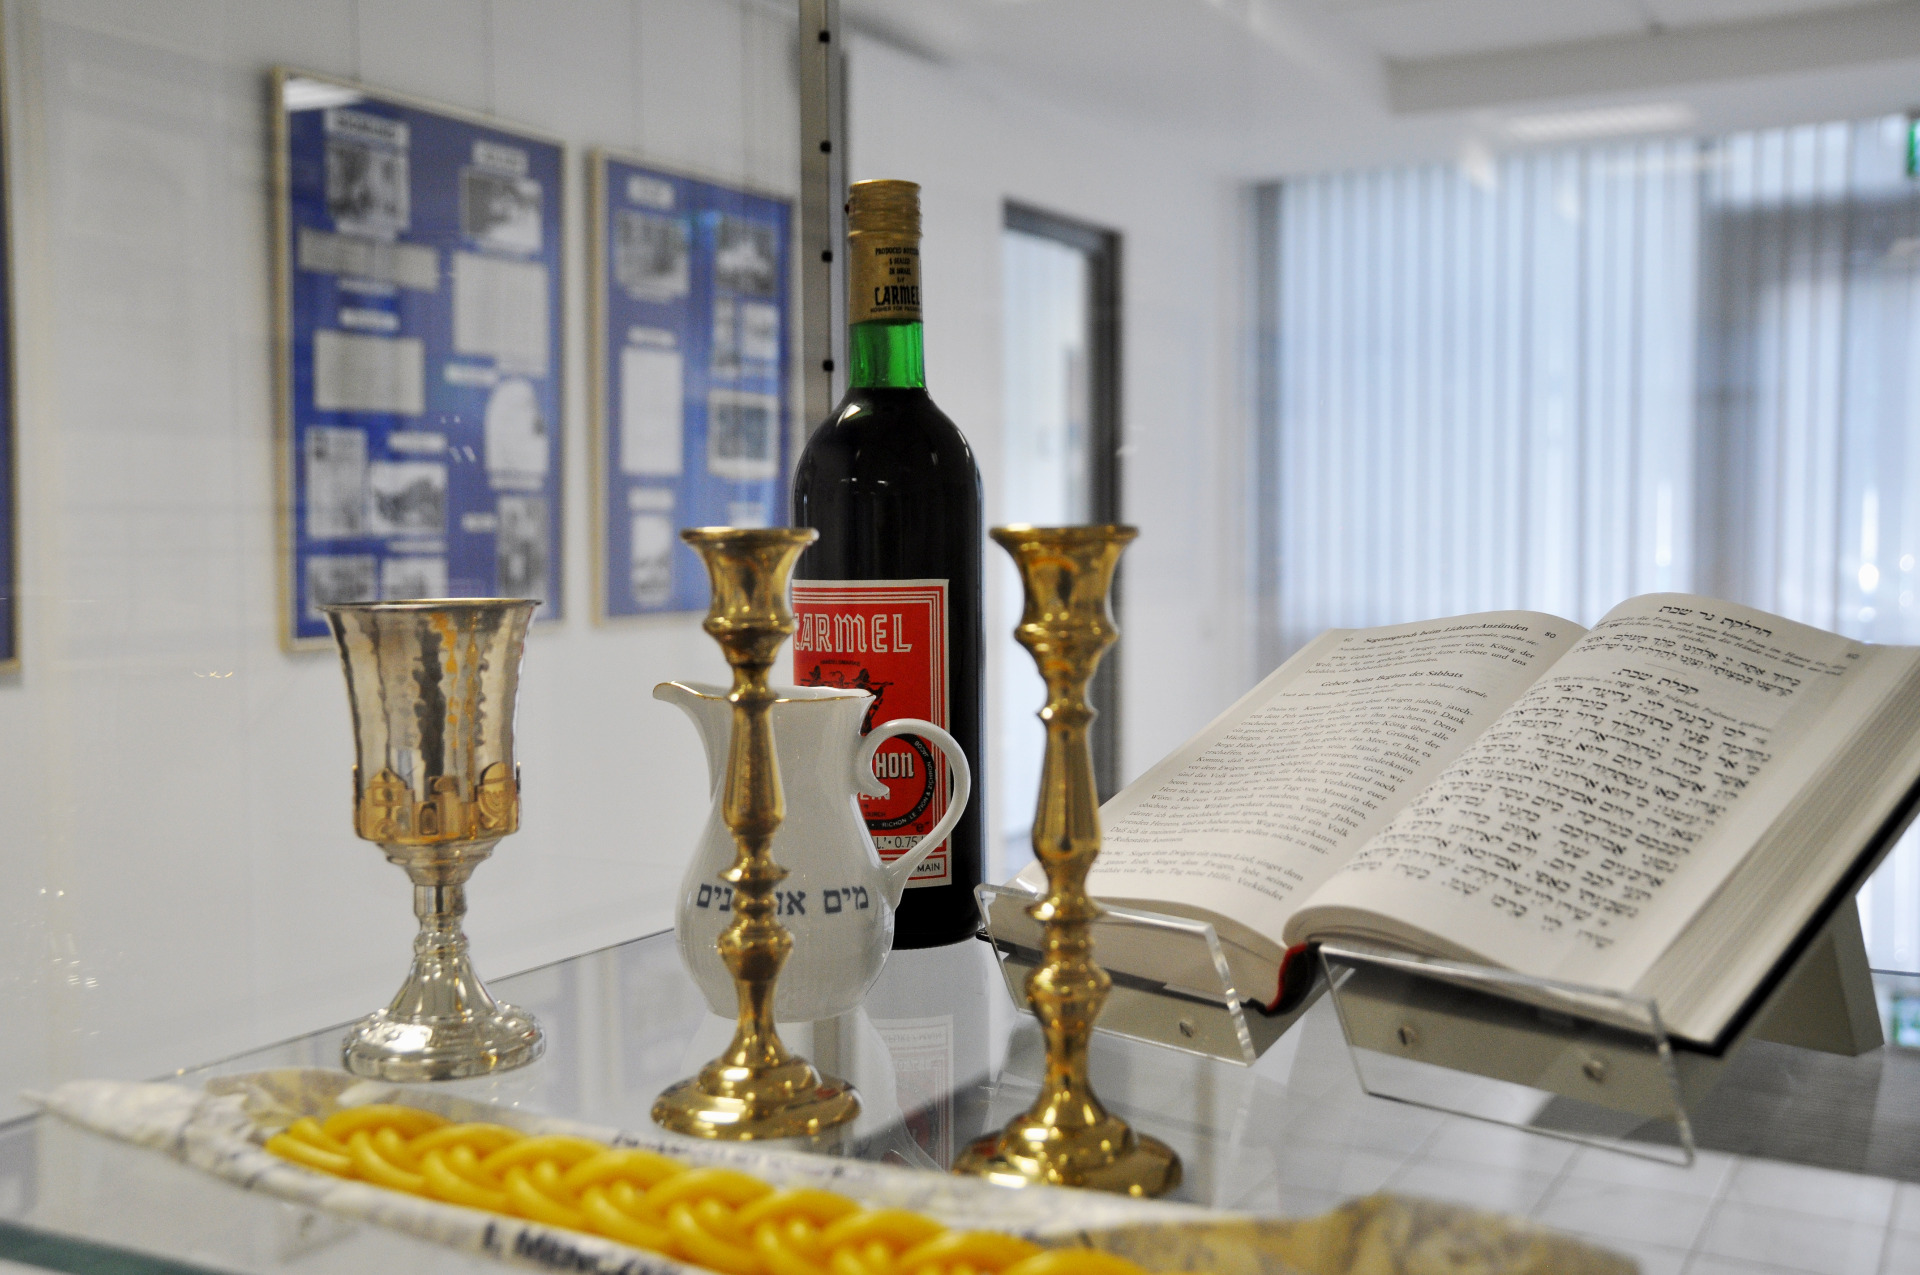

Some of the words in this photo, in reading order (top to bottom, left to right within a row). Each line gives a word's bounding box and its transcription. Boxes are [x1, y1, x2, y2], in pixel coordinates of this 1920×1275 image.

[874, 285, 920, 305] CARMEL
[794, 612, 912, 653] CARMEL
[1544, 630, 1557, 640] 80
[1489, 641, 1516, 654] König
[1519, 649, 1535, 660] der
[1491, 650, 1508, 661] und
[1511, 657, 1528, 667] uns
[1428, 670, 1464, 679] Sabbats
[1414, 697, 1443, 709] jubeln,
[1446, 702, 1473, 717] jauch-
[1432, 718, 1457, 734] Denn
[1440, 710, 1465, 726] Dank
[1382, 719, 1409, 732] König
[1409, 723, 1431, 735] über
[1431, 730, 1450, 743] alle
[1386, 729, 1421, 744] Gründe,
[1424, 738, 1441, 750] der
[1383, 749, 1422, 768] gebildet.
[1404, 742, 1420, 755] hat
[1421, 750, 1432, 759] es
[1363, 755, 1414, 776] niederknien
[1363, 764, 1386, 778] Gott,
[1389, 772, 1406, 784] wir
[1373, 779, 1397, 794] noch
[1350, 793, 1361, 804] in
[1361, 799, 1379, 811] der
[1366, 789, 1389, 803] euer
[1329, 801, 1367, 821] prüften,
[1331, 812, 1359, 829] Jahre
[1326, 822, 1349, 839] Volk
[917, 862, 941, 873] MAIN
[823, 885, 869, 914] מים
